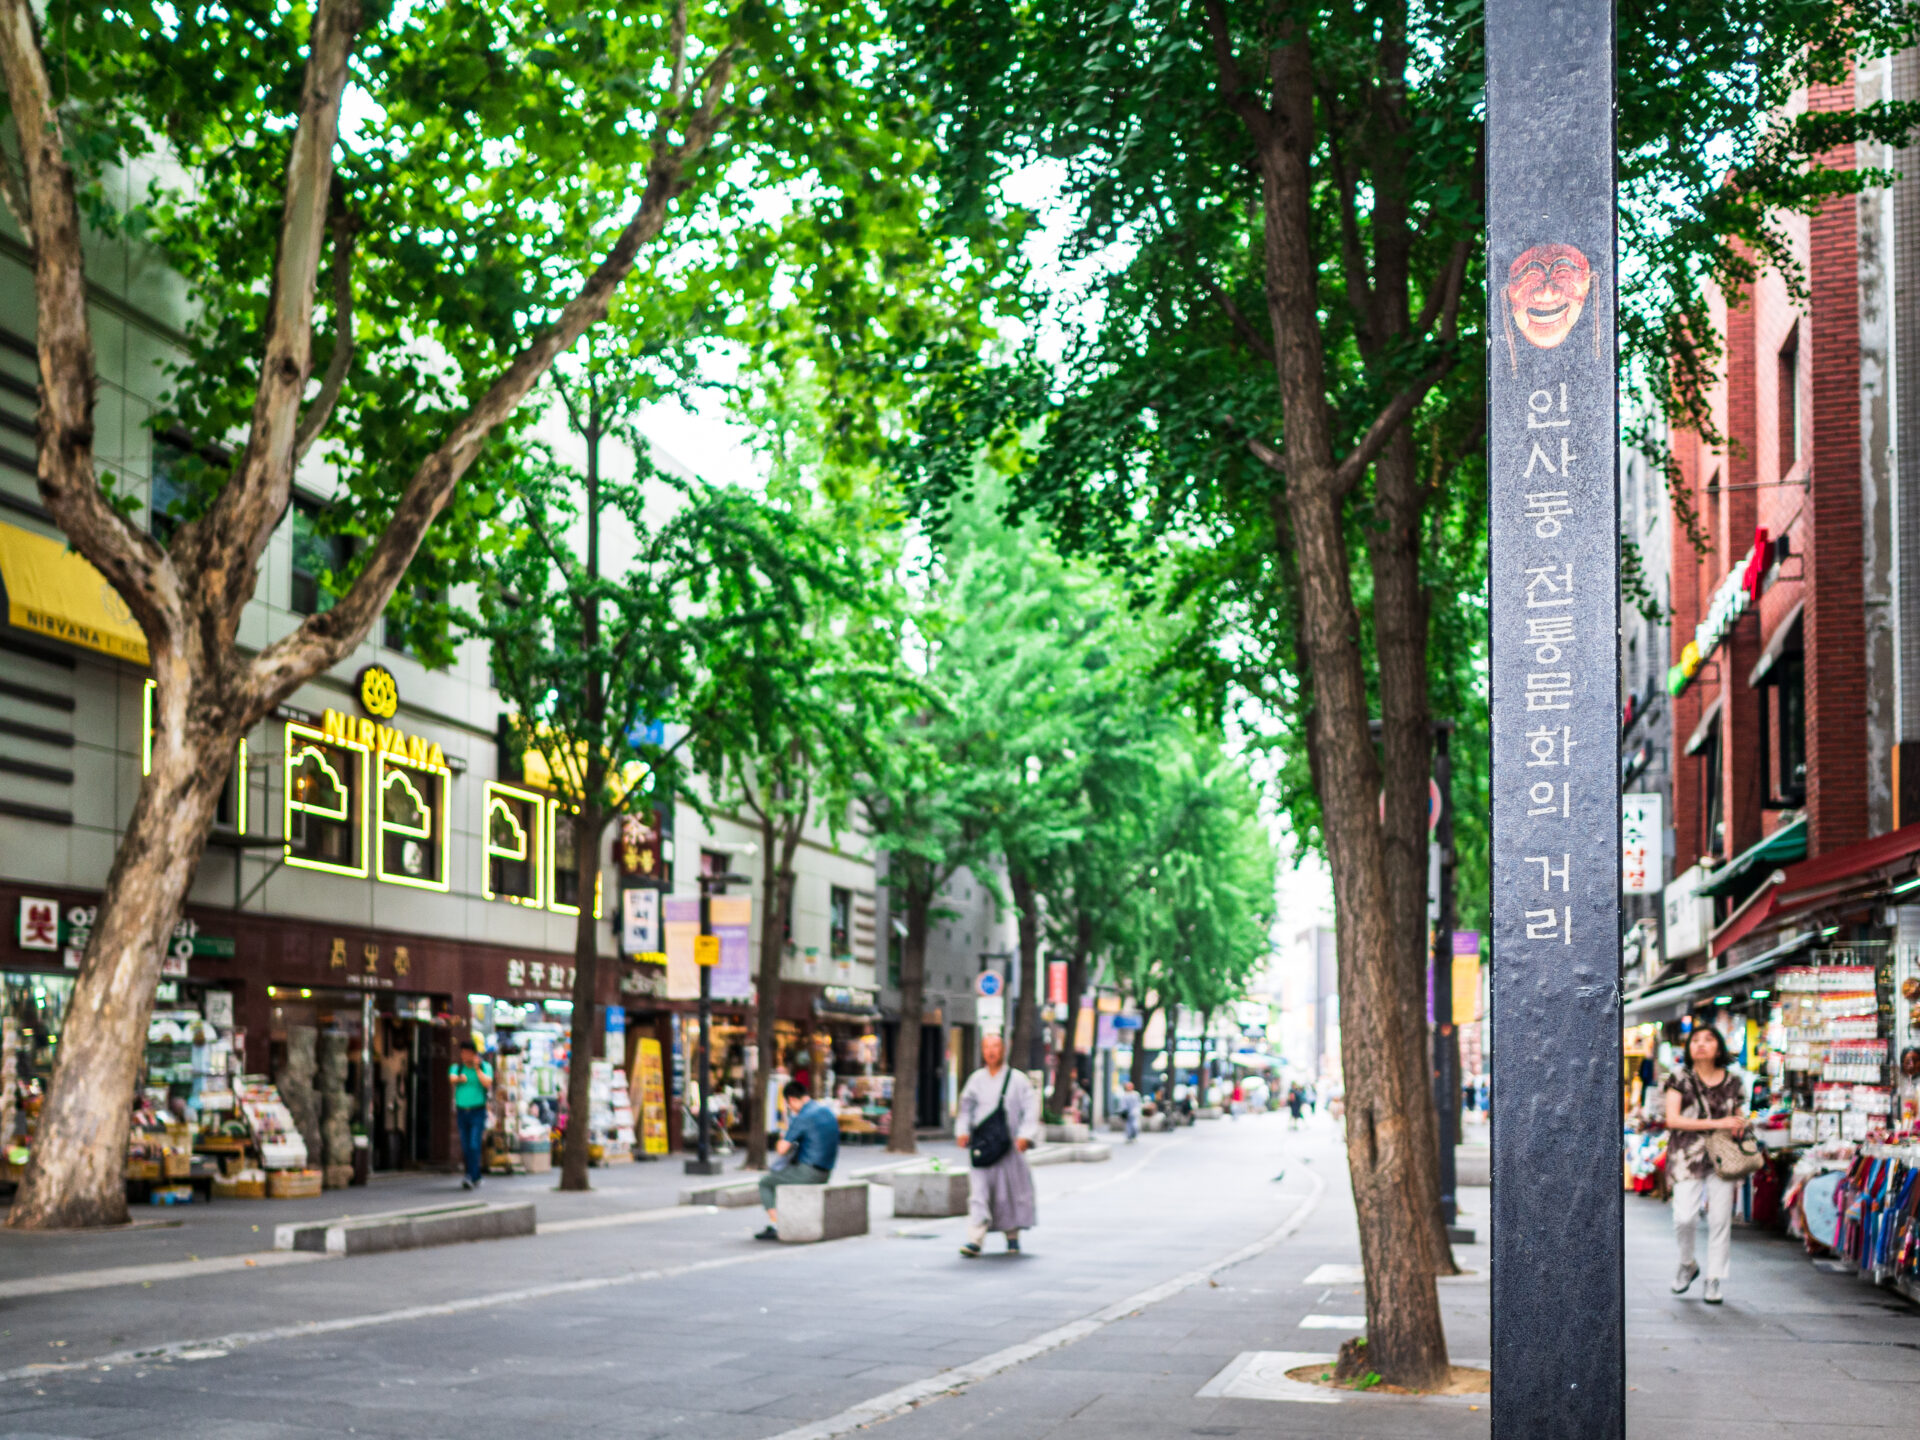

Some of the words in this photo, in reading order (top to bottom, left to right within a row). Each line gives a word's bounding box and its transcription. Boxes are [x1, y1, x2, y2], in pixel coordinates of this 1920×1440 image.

[1522, 382, 1578, 539] 인사동
[26, 609, 101, 645] NIRVANA
[1522, 563, 1578, 818] 전통문화의
[323, 707, 446, 768] NIRVANA
[1523, 852, 1572, 945] 거리
